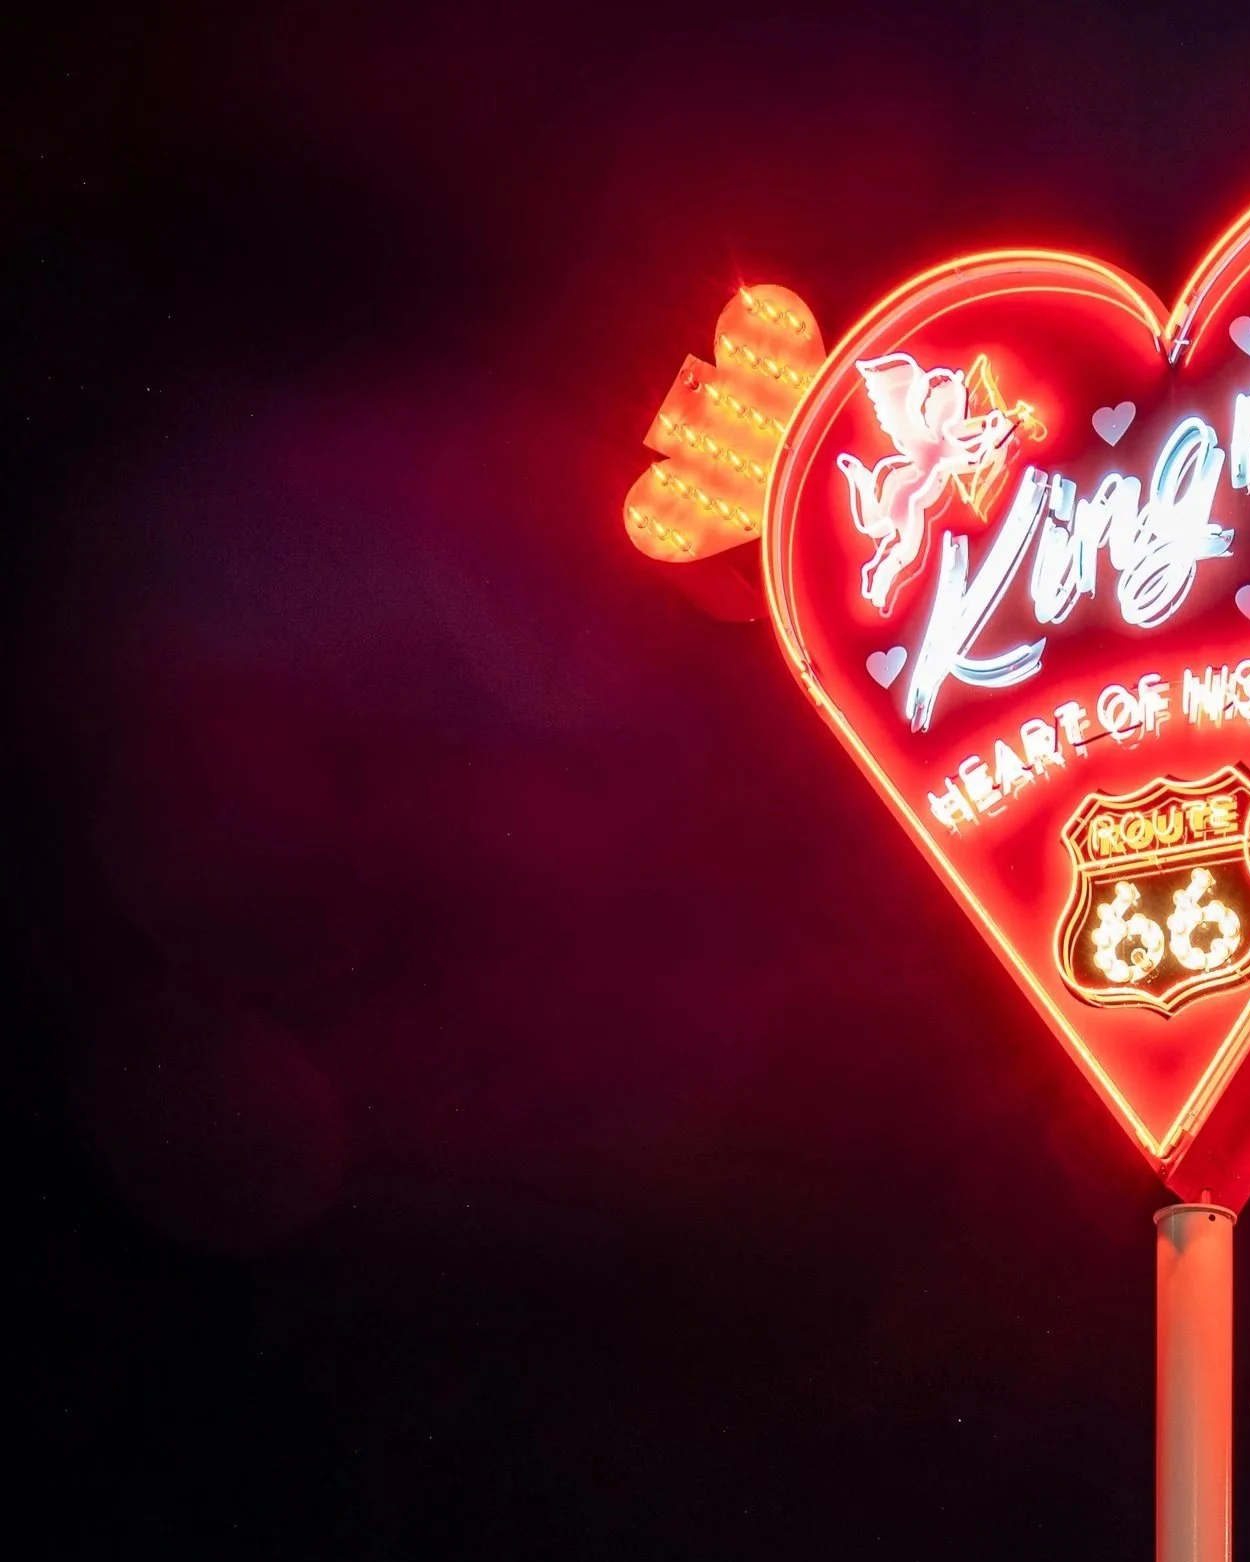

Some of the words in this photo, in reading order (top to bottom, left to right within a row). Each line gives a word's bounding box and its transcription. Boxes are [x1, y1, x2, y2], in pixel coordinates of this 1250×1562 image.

[927, 700, 1091, 834] HEART
[1097, 672, 1175, 748] OF
[1087, 795, 1240, 858] ROUTE
[1092, 867, 1241, 983] 66
